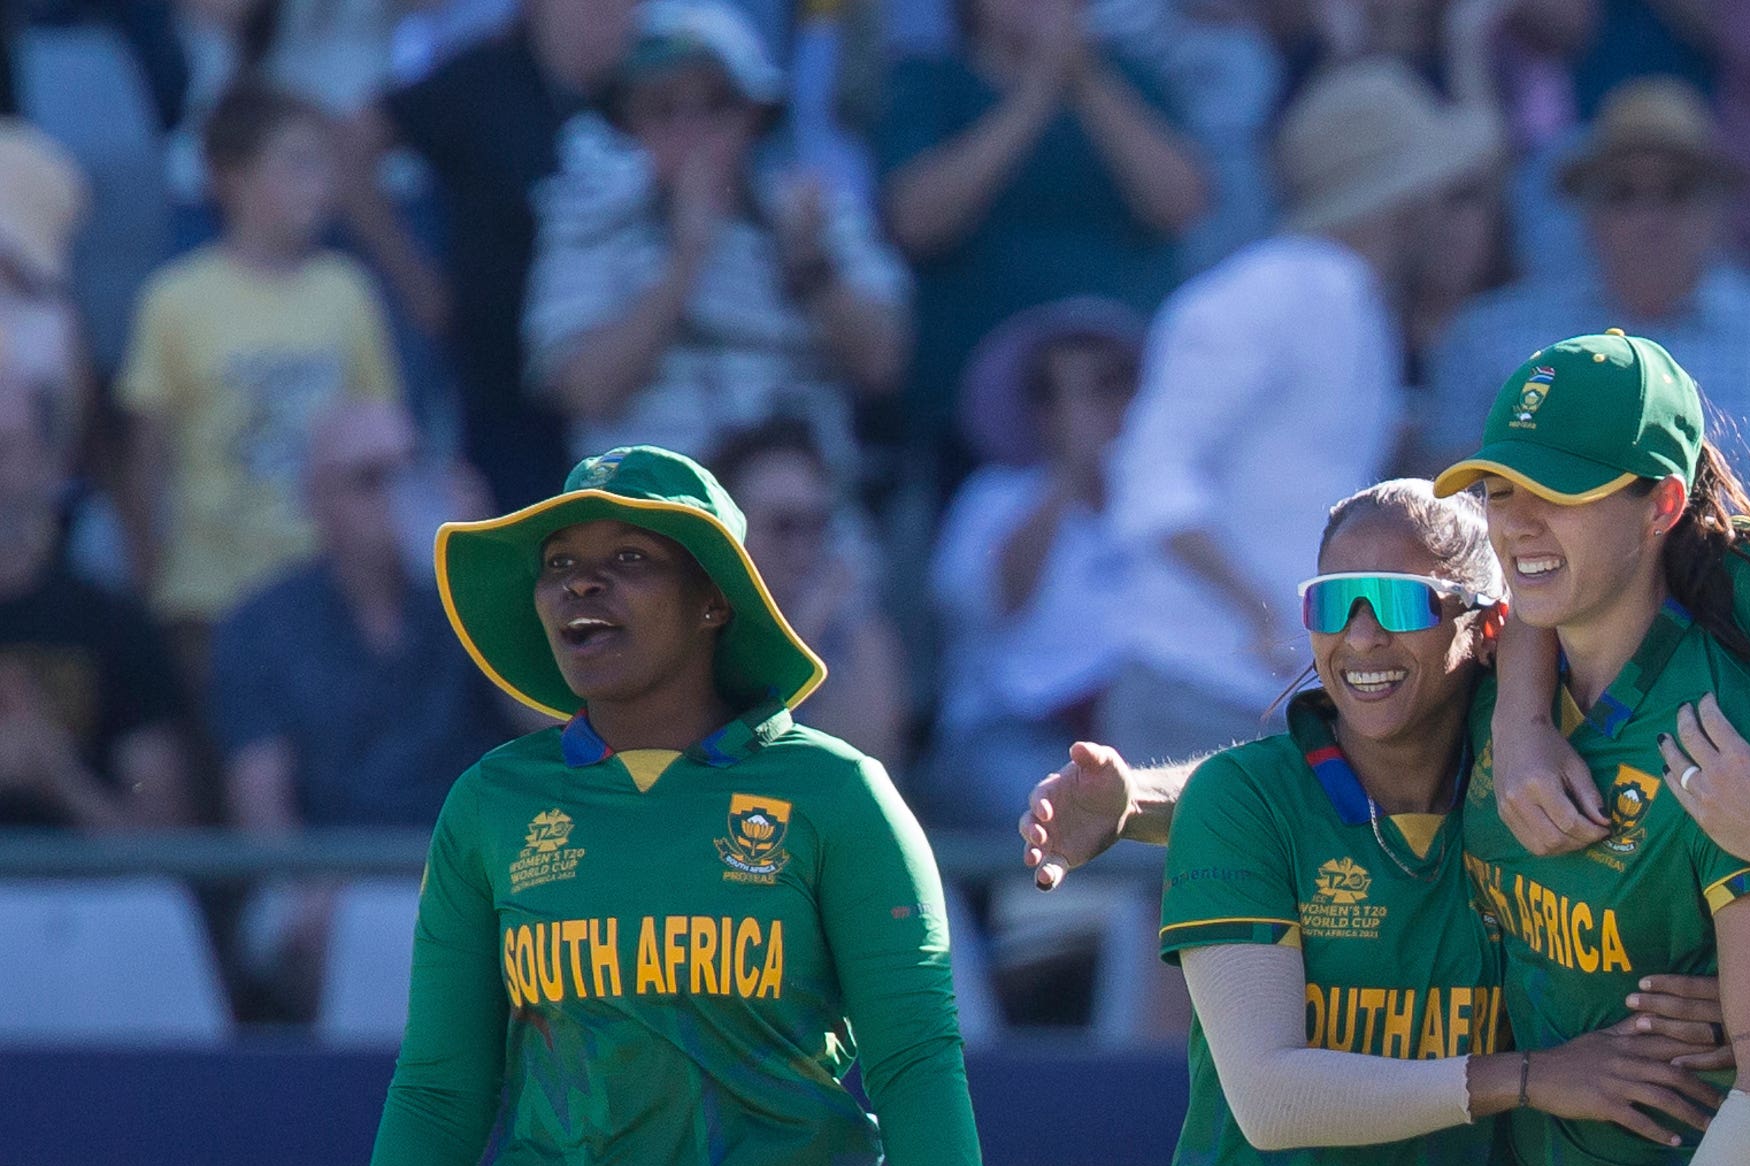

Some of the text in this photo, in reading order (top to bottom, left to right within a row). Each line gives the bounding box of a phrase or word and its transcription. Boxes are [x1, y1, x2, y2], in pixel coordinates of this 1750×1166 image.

[502, 914, 784, 1009] SOUTH AFRICA
[1351, 917, 1381, 929] CUP
[1515, 873, 1632, 974] AFRICA
[1305, 982, 1500, 1061] OUTH AFRI
